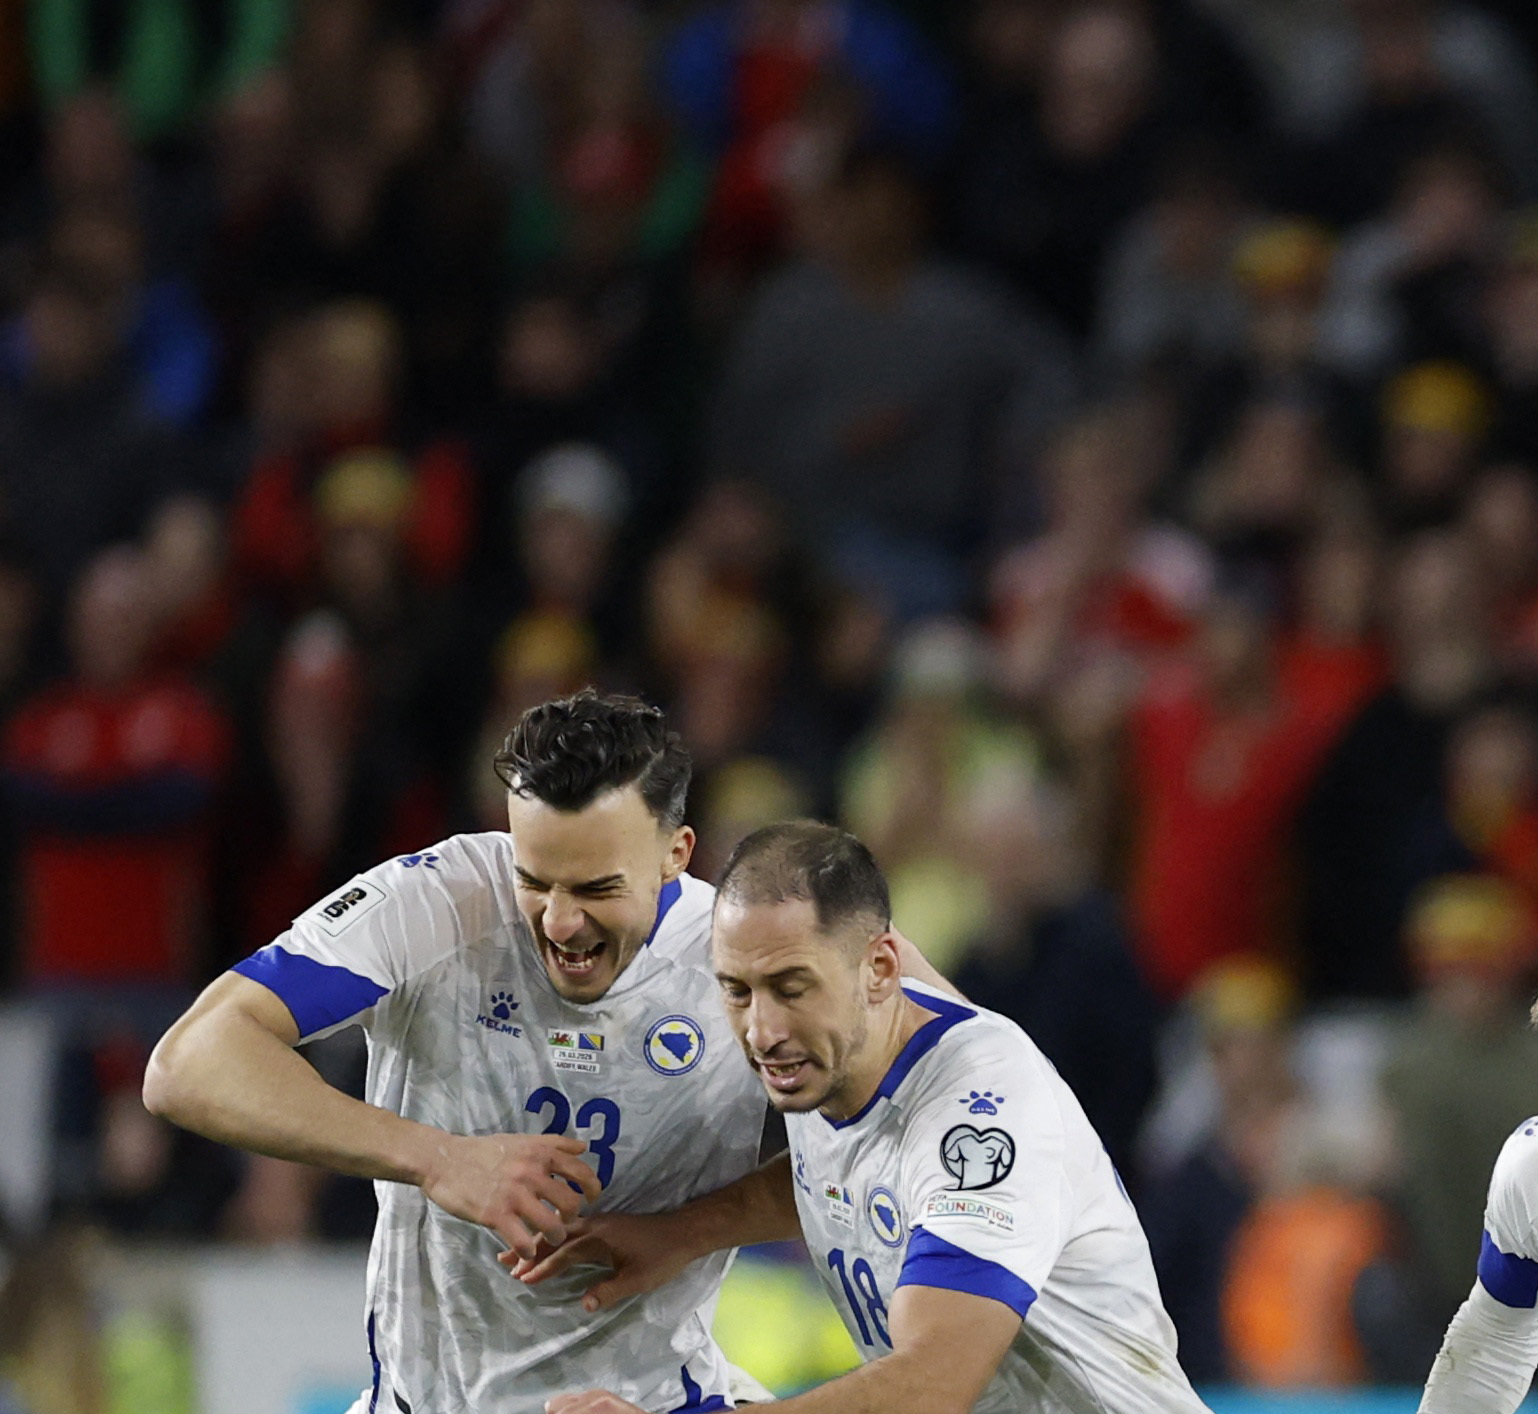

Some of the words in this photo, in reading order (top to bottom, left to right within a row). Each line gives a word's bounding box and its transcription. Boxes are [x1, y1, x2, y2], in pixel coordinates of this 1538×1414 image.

[475, 1015, 522, 1038] KELME
[927, 1202, 1014, 1224] FOUNDATION
[828, 1248, 893, 1349] 18
